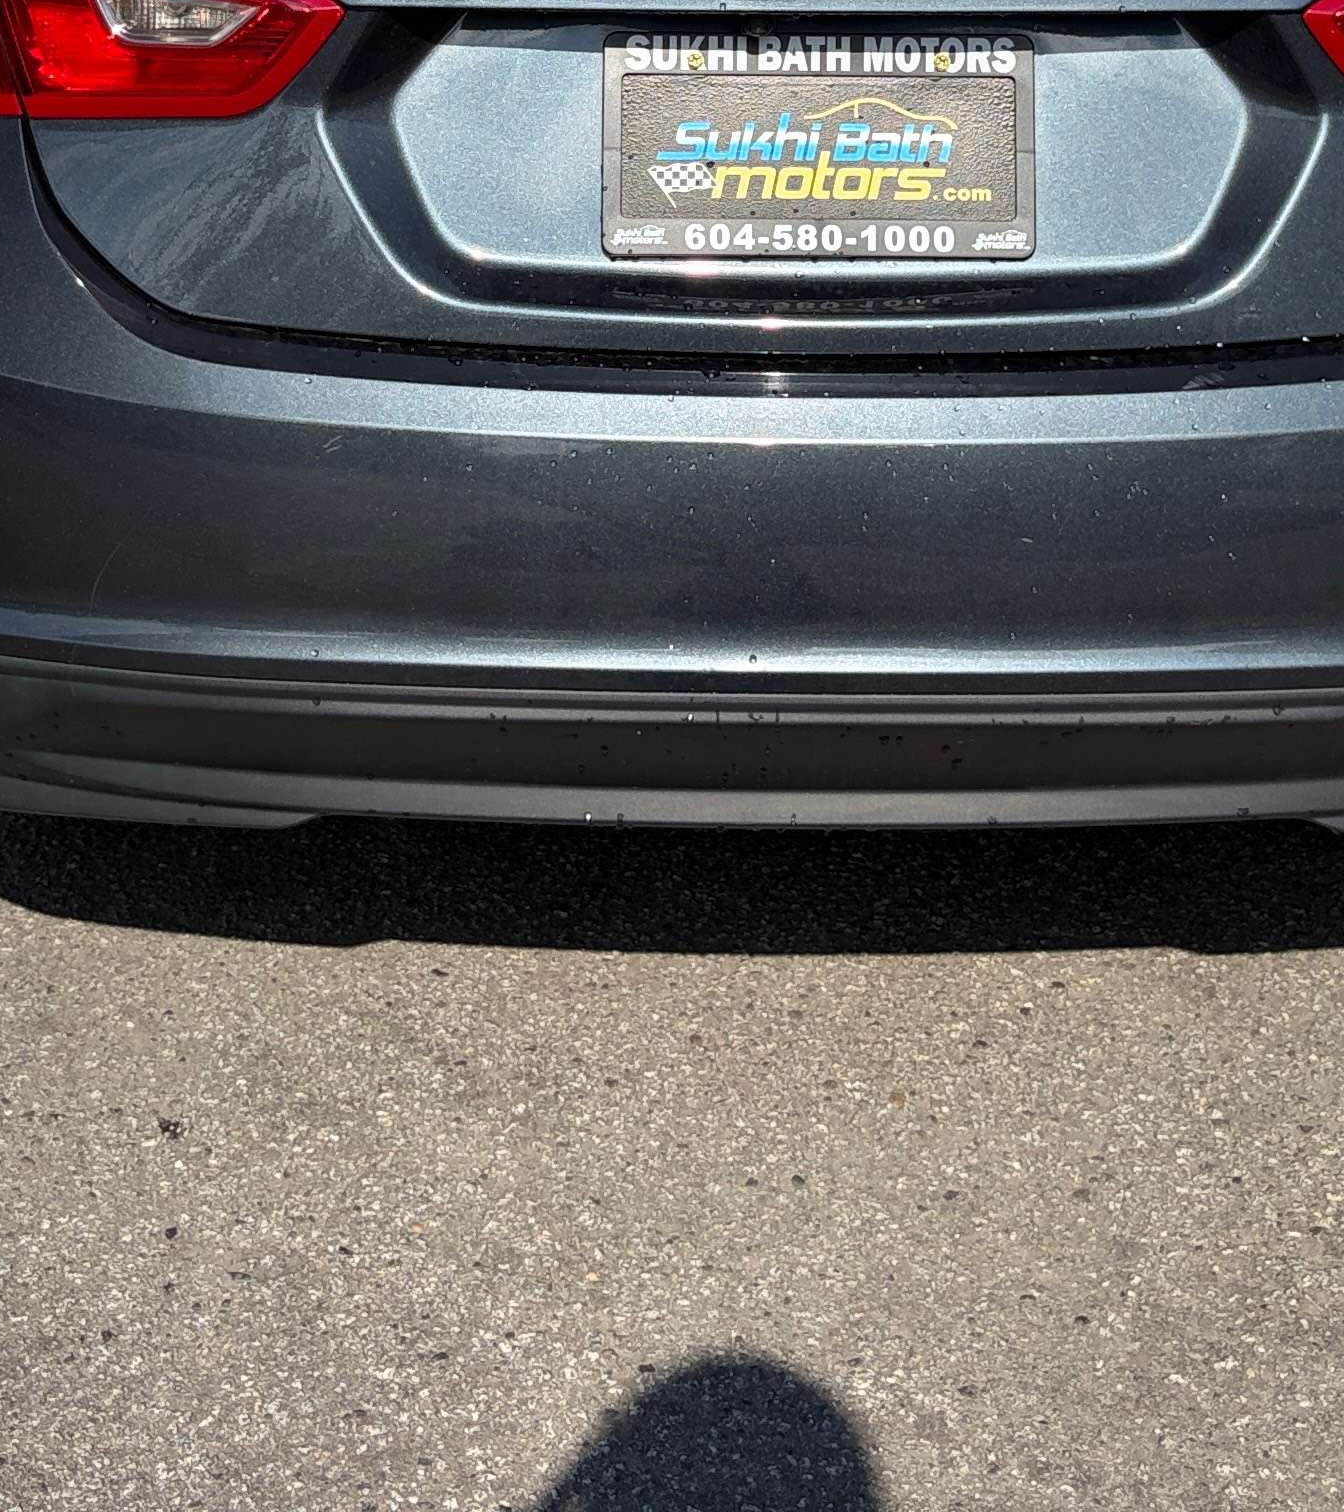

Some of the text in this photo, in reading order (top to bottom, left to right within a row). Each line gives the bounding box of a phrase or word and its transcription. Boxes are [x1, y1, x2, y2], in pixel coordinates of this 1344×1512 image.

[624, 35, 1017, 73] SUKHI BATH MOTORS
[656, 112, 953, 163] Sukhi Bath
[684, 224, 955, 252] 604-580-1000
